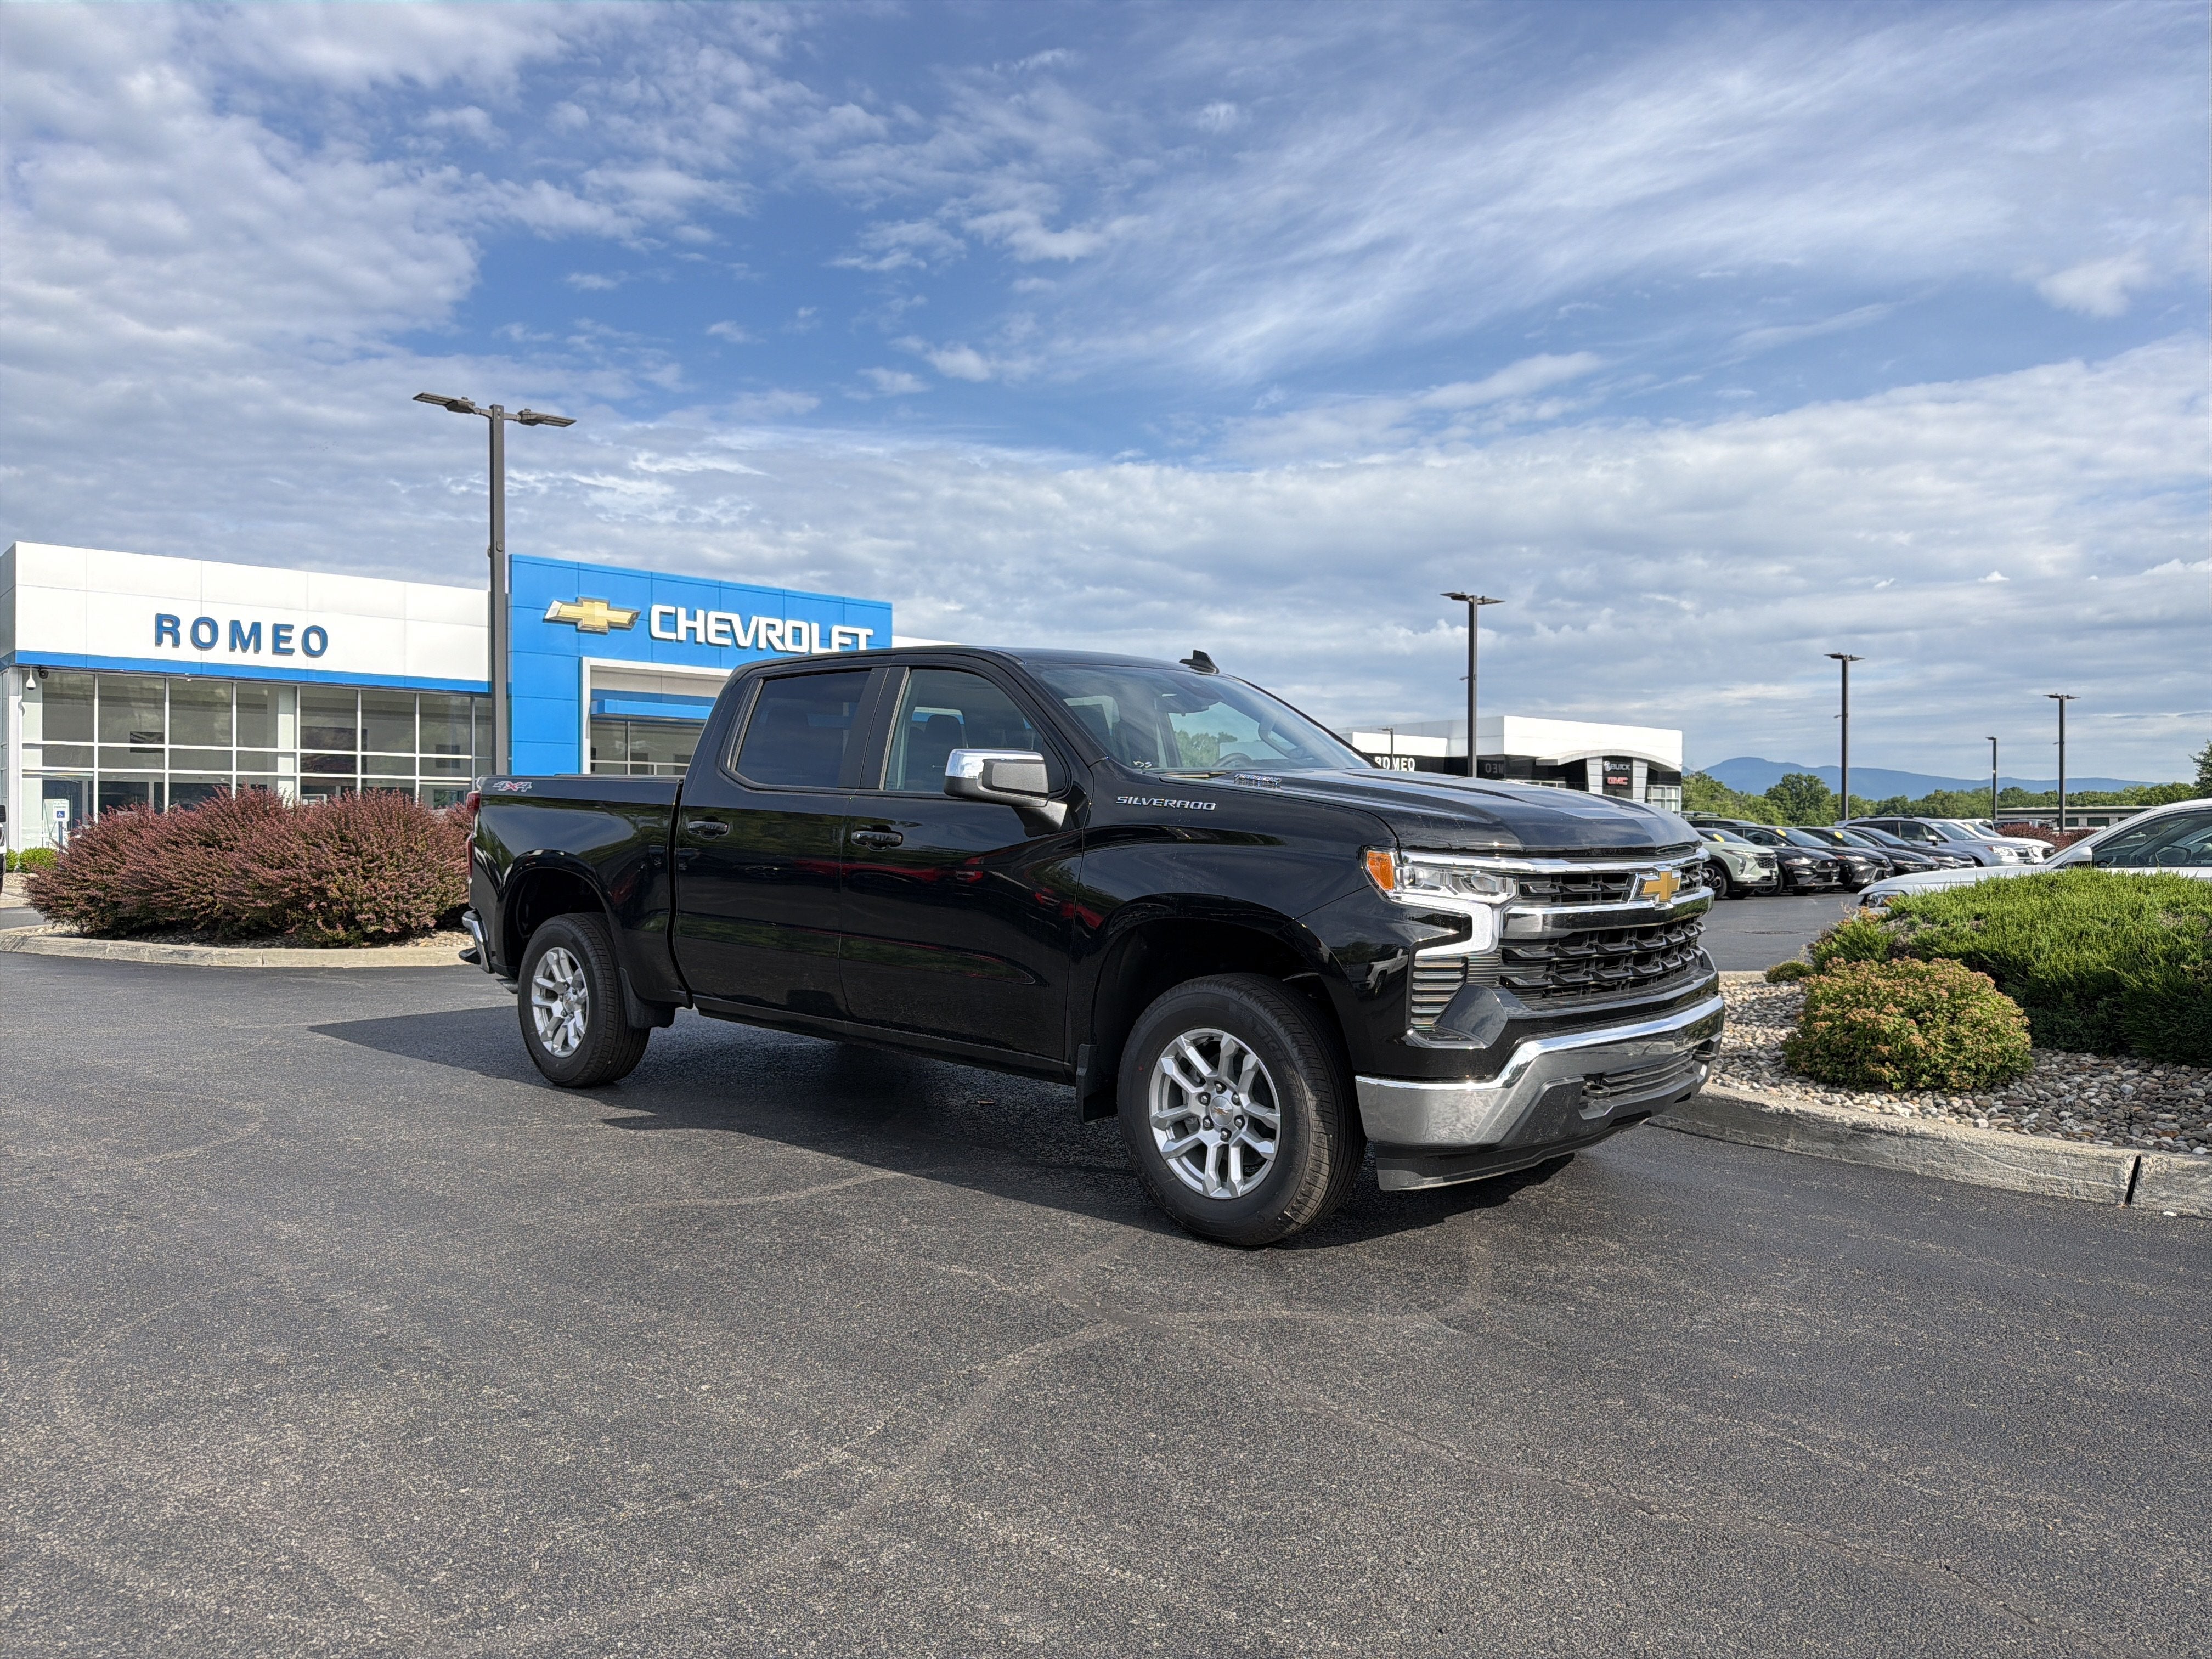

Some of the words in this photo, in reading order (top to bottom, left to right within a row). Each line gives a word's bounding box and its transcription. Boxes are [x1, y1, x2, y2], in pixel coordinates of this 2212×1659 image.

[155, 613, 328, 658] ROMEO
[650, 603, 873, 654] CHEVROLET
[1607, 776, 1628, 785] GMC
[1116, 795, 1216, 811] SILVERADO
